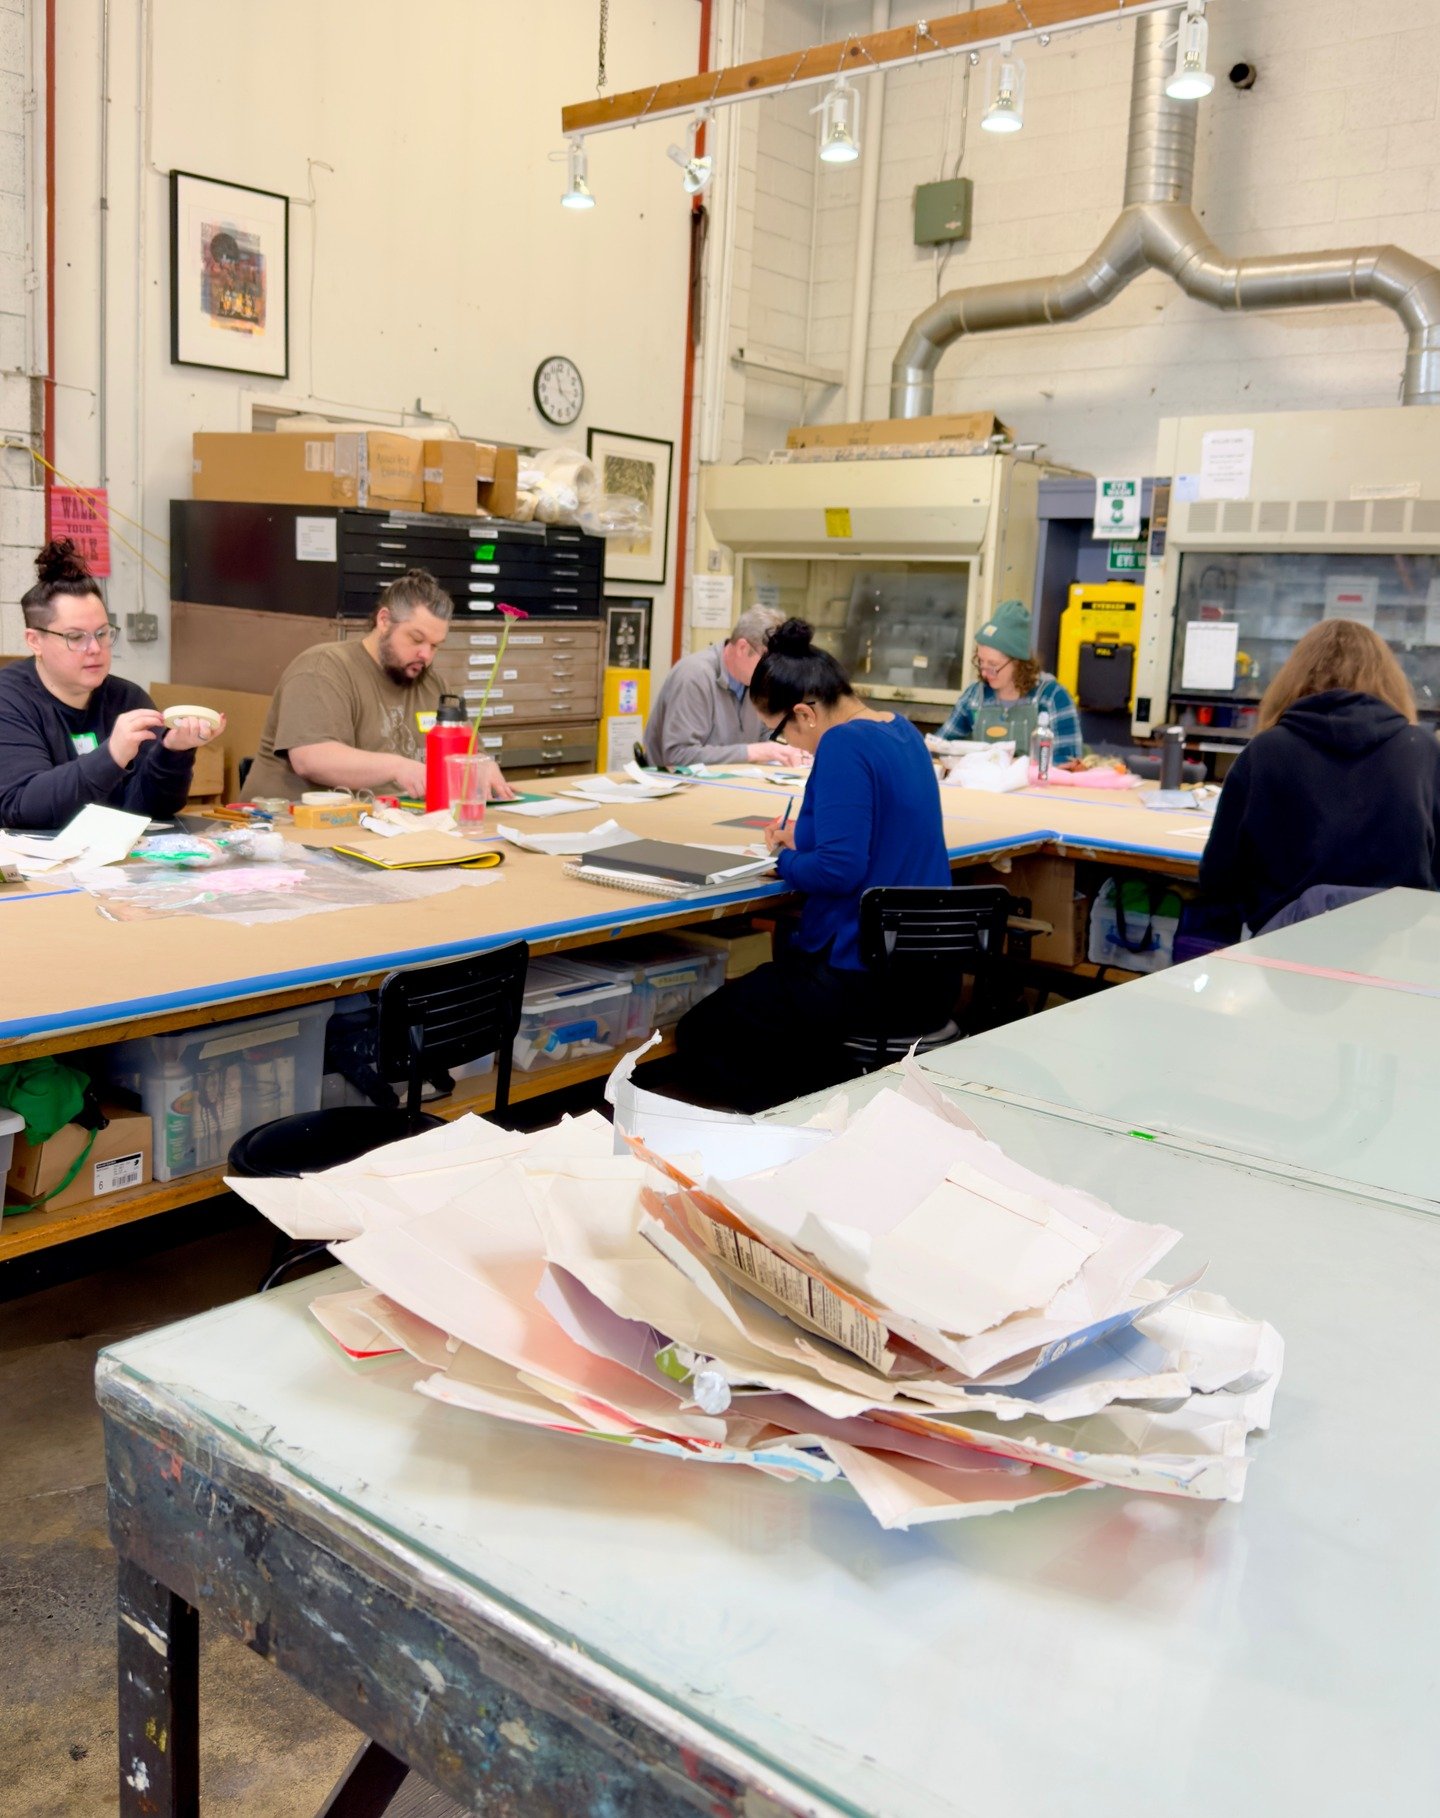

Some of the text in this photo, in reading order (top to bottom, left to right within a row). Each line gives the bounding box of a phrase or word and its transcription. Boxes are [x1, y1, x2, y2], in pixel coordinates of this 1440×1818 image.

[61, 496, 97, 519] WALK
[66, 524, 92, 533] YOUR
[1116, 555, 1136, 567] EYE
[98, 1180, 103, 1190] 6
